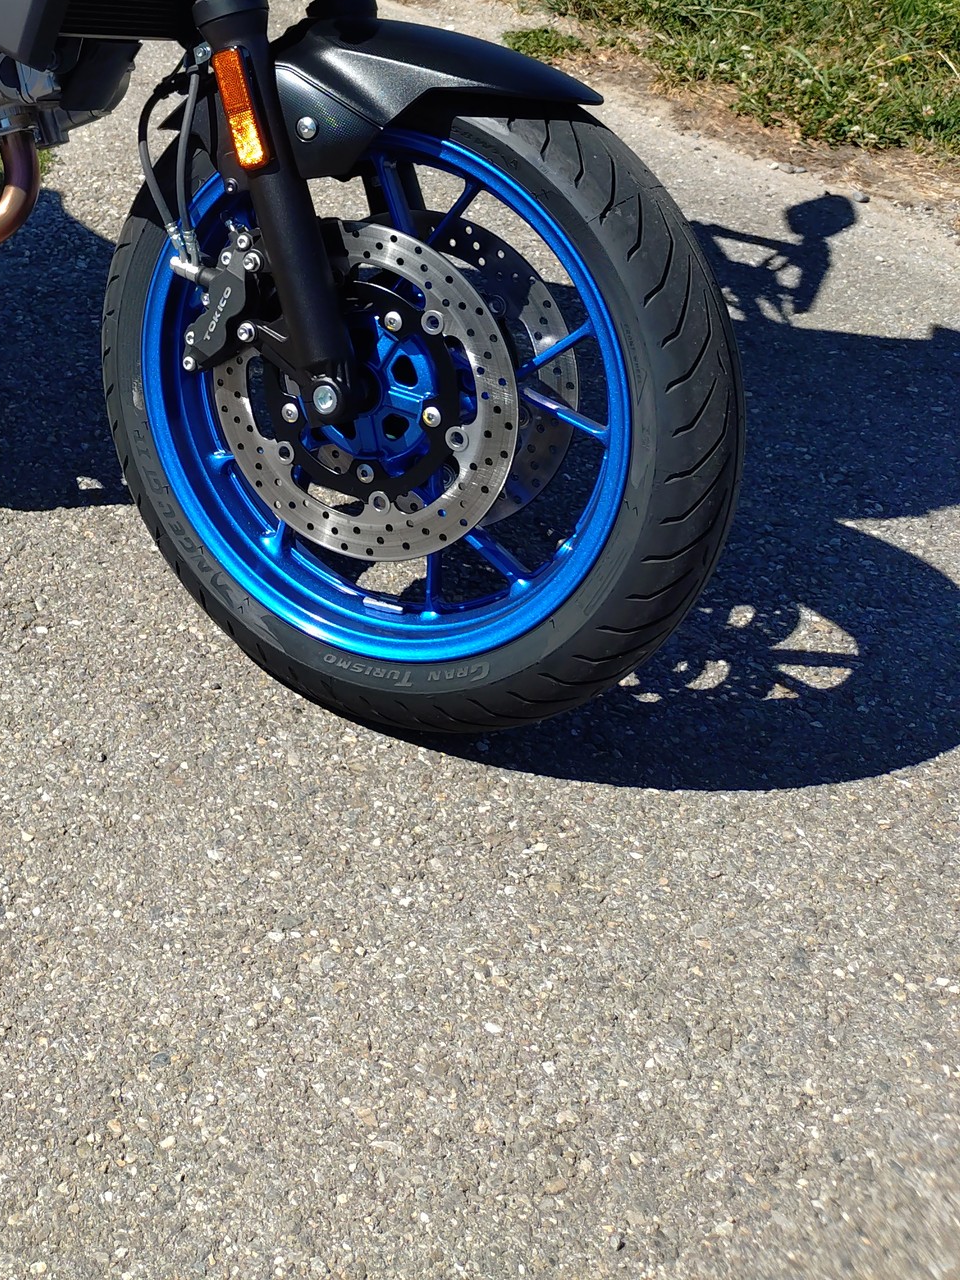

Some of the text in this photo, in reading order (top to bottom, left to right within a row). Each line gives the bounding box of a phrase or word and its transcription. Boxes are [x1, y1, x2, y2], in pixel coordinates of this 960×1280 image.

[203, 286, 232, 340] TOKICO
[161, 504, 235, 609] ANGEL
[323, 653, 490, 687] GRAN TURISMO
